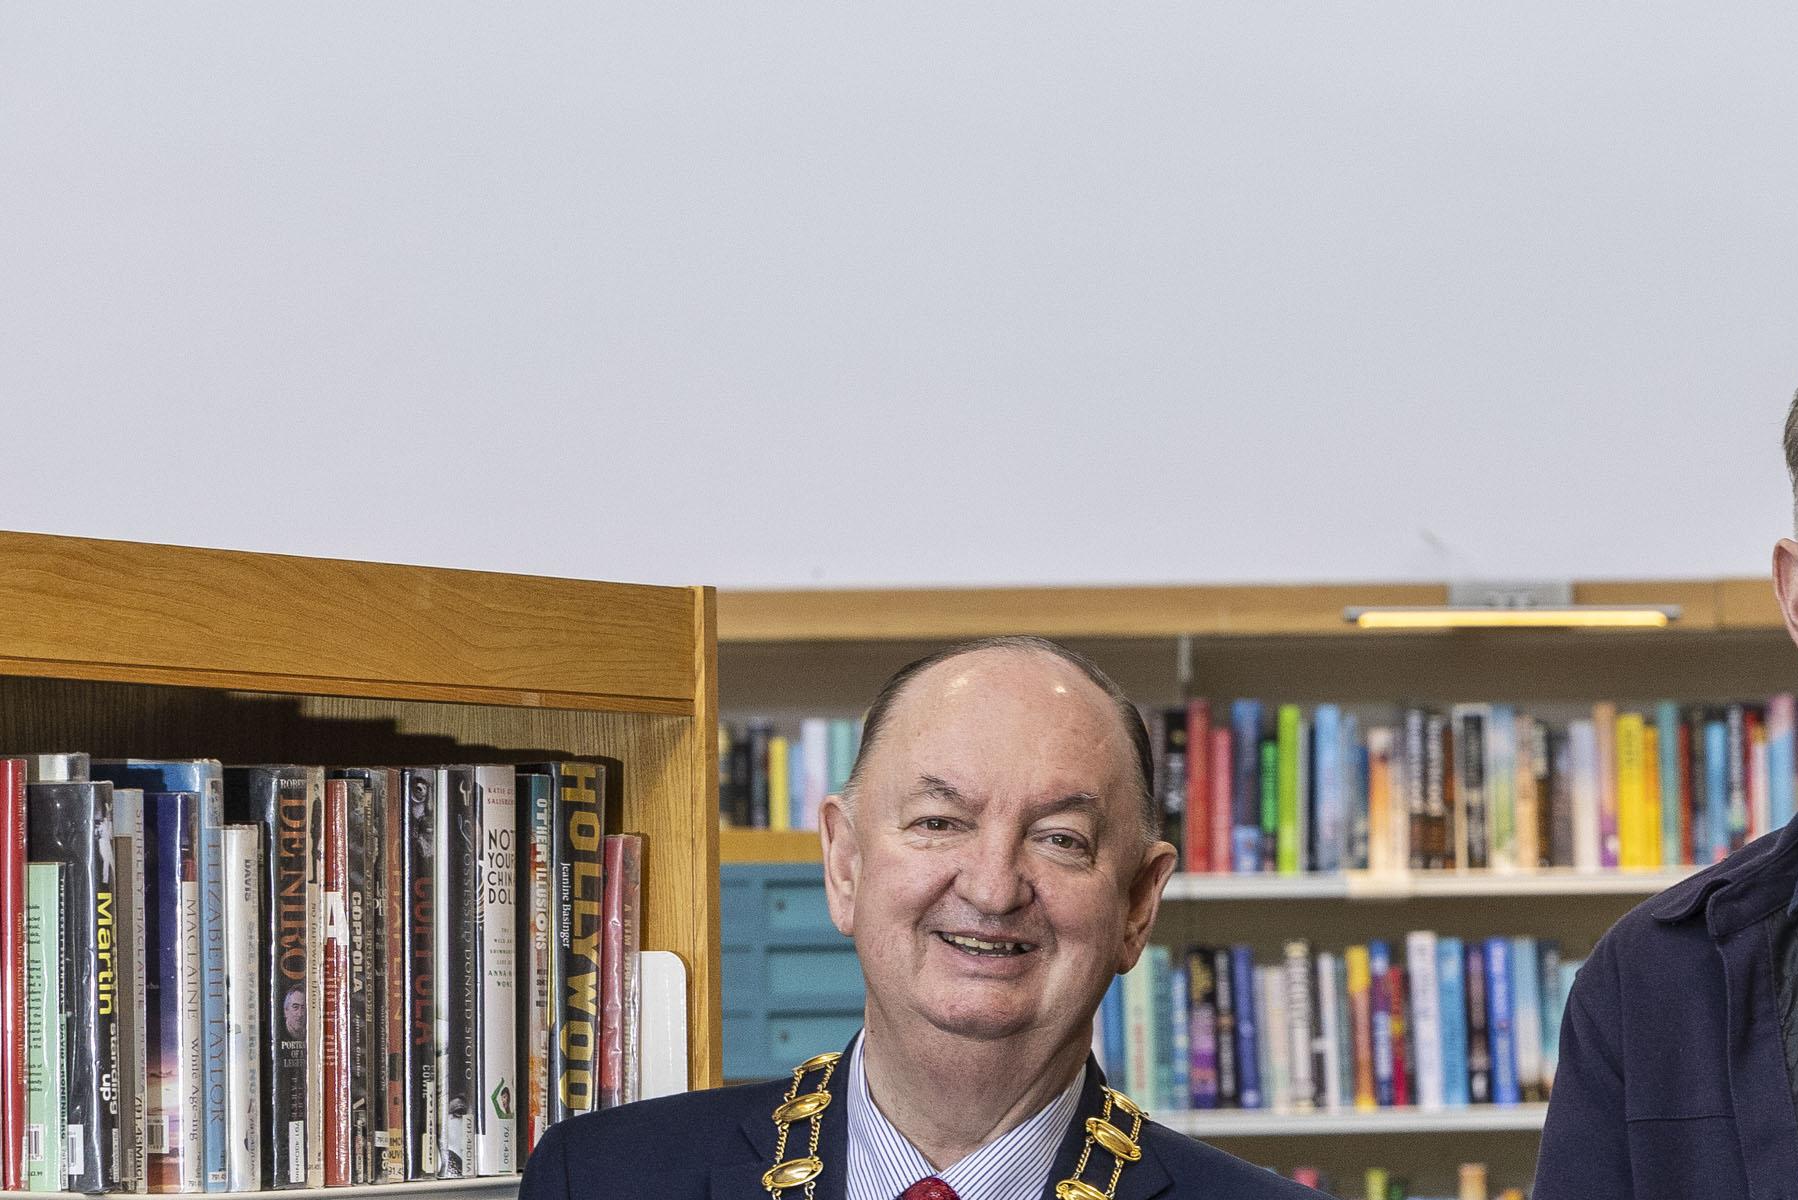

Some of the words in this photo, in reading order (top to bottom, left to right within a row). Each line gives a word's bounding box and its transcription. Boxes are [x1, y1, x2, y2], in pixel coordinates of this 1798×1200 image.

[280, 794, 306, 857] DE
[536, 798, 548, 866] OTHER
[243, 859, 253, 902] DAVIS
[535, 867, 548, 950] ILLUSIONS
[560, 863, 572, 901] Jeanine
[97, 892, 115, 1015] Martin
[207, 843, 223, 999] ELIZABETH
[280, 867, 306, 980] NIRO
[351, 891, 363, 993] COPPOLA
[559, 903, 572, 949] Basinger
[559, 763, 602, 1112] HOLLYWOO
[186, 899, 198, 1021] MACLAINE
[464, 949, 474, 1020] DONALD
[101, 1073, 113, 1101] up
[108, 1023, 119, 1115] standing
[190, 1037, 201, 1080] While
[208, 1016, 224, 1125] TAYLOR
[464, 1025, 474, 1081] SPOTO
[189, 1083, 201, 1141] Age-ing
